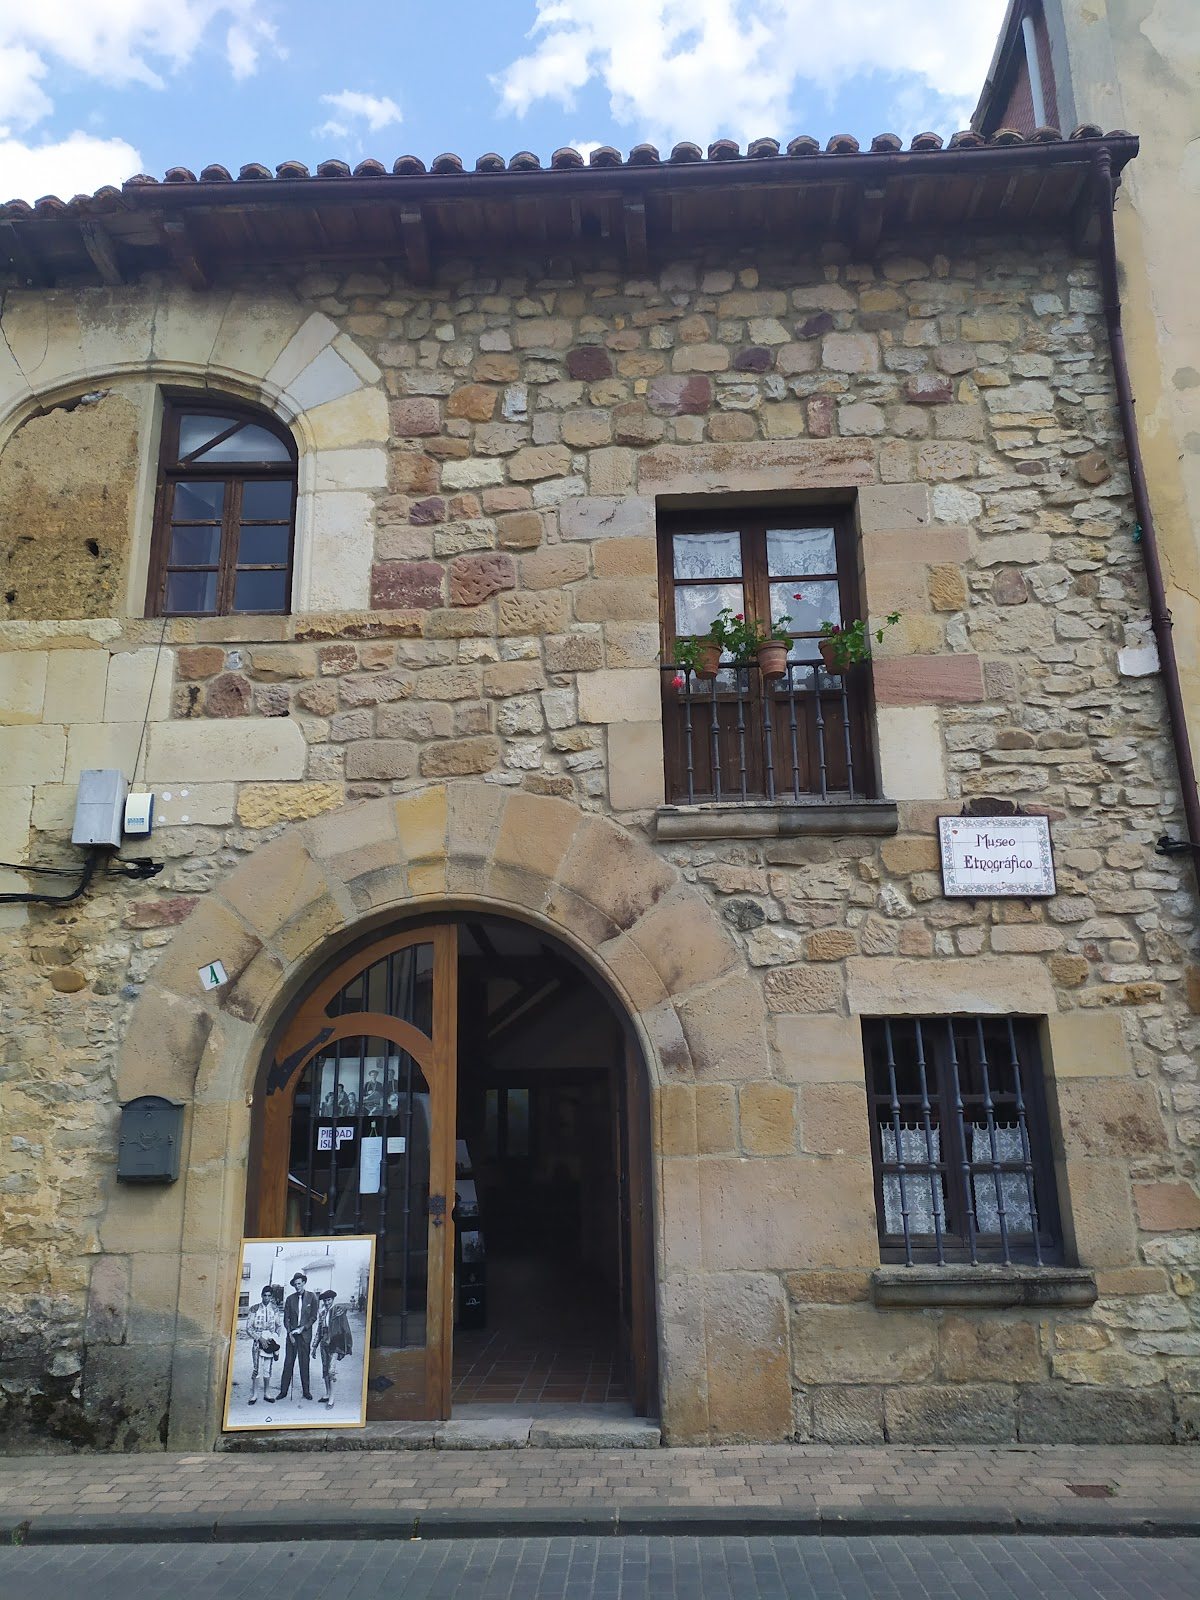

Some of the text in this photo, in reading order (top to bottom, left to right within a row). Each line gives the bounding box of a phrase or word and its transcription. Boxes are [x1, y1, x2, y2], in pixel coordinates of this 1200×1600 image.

[974, 833, 1016, 849] Museo
[963, 854, 1033, 874] Etnográfico
[209, 965, 220, 984] 4
[320, 1139, 338, 1149] ISL
